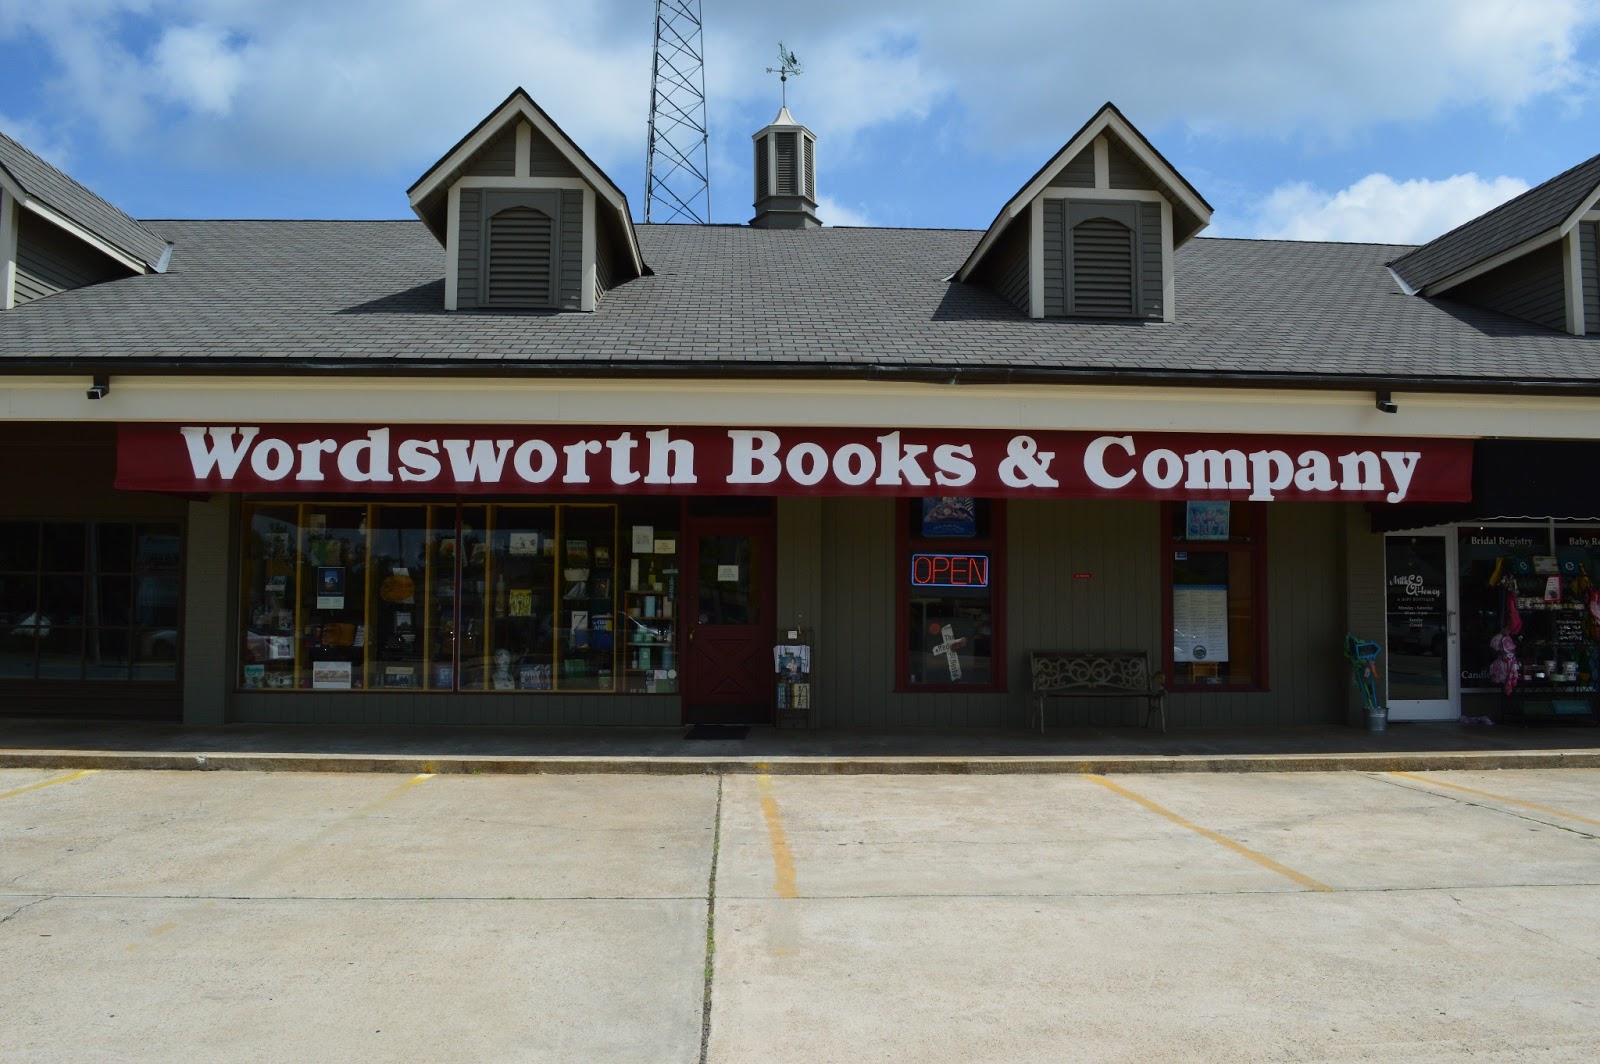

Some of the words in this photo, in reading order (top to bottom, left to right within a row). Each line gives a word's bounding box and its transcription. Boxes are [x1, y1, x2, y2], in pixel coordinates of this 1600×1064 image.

[182, 427, 697, 484] Wordsworth
[726, 431, 976, 486] Books
[998, 436, 1059, 487] &
[1084, 436, 1420, 503] Company
[1471, 536, 1496, 545] Bridal
[1499, 536, 1533, 547] Registry
[1569, 537, 1590, 548] Baby
[914, 556, 986, 585] OPEN
[1417, 585, 1440, 597] Honey
